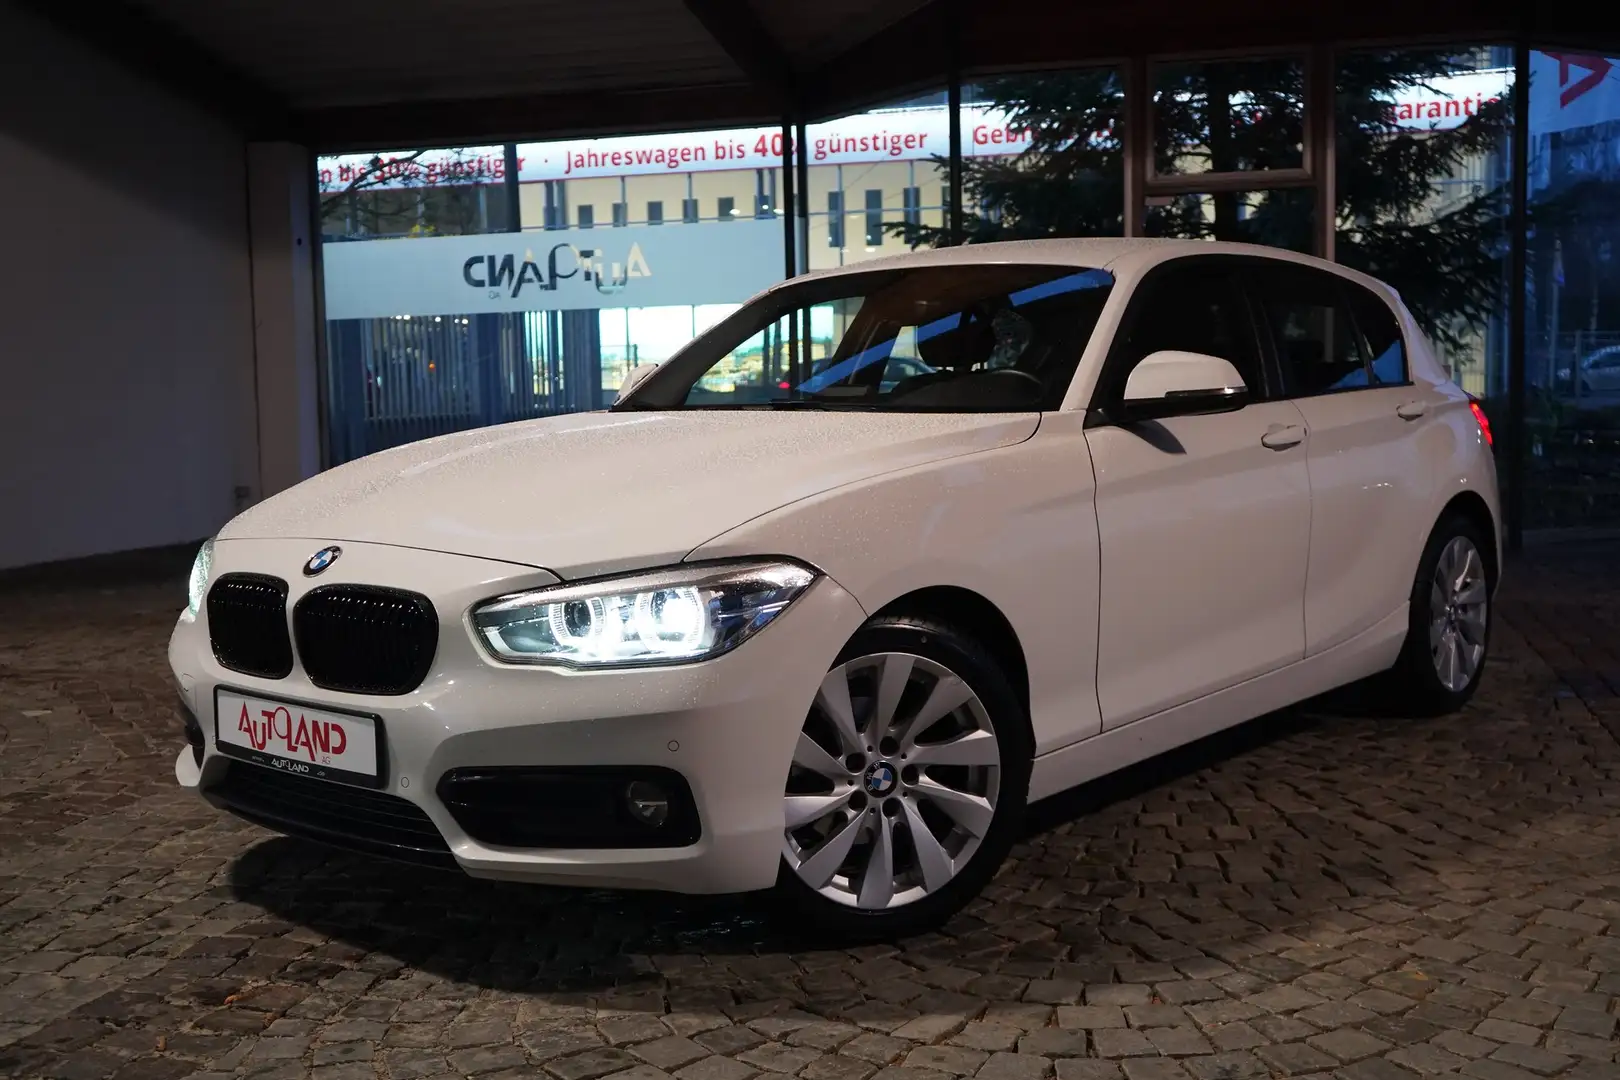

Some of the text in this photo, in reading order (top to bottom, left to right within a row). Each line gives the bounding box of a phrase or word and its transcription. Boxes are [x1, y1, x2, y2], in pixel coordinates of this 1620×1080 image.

[564, 144, 705, 174] Jahreswagen
[715, 139, 745, 161] bis
[814, 130, 928, 161] günstiger
[426, 155, 525, 184] günstigr
[238, 701, 347, 761] AUTOLAND
[271, 758, 309, 773] AUTOLAND
[321, 756, 331, 765] AG
